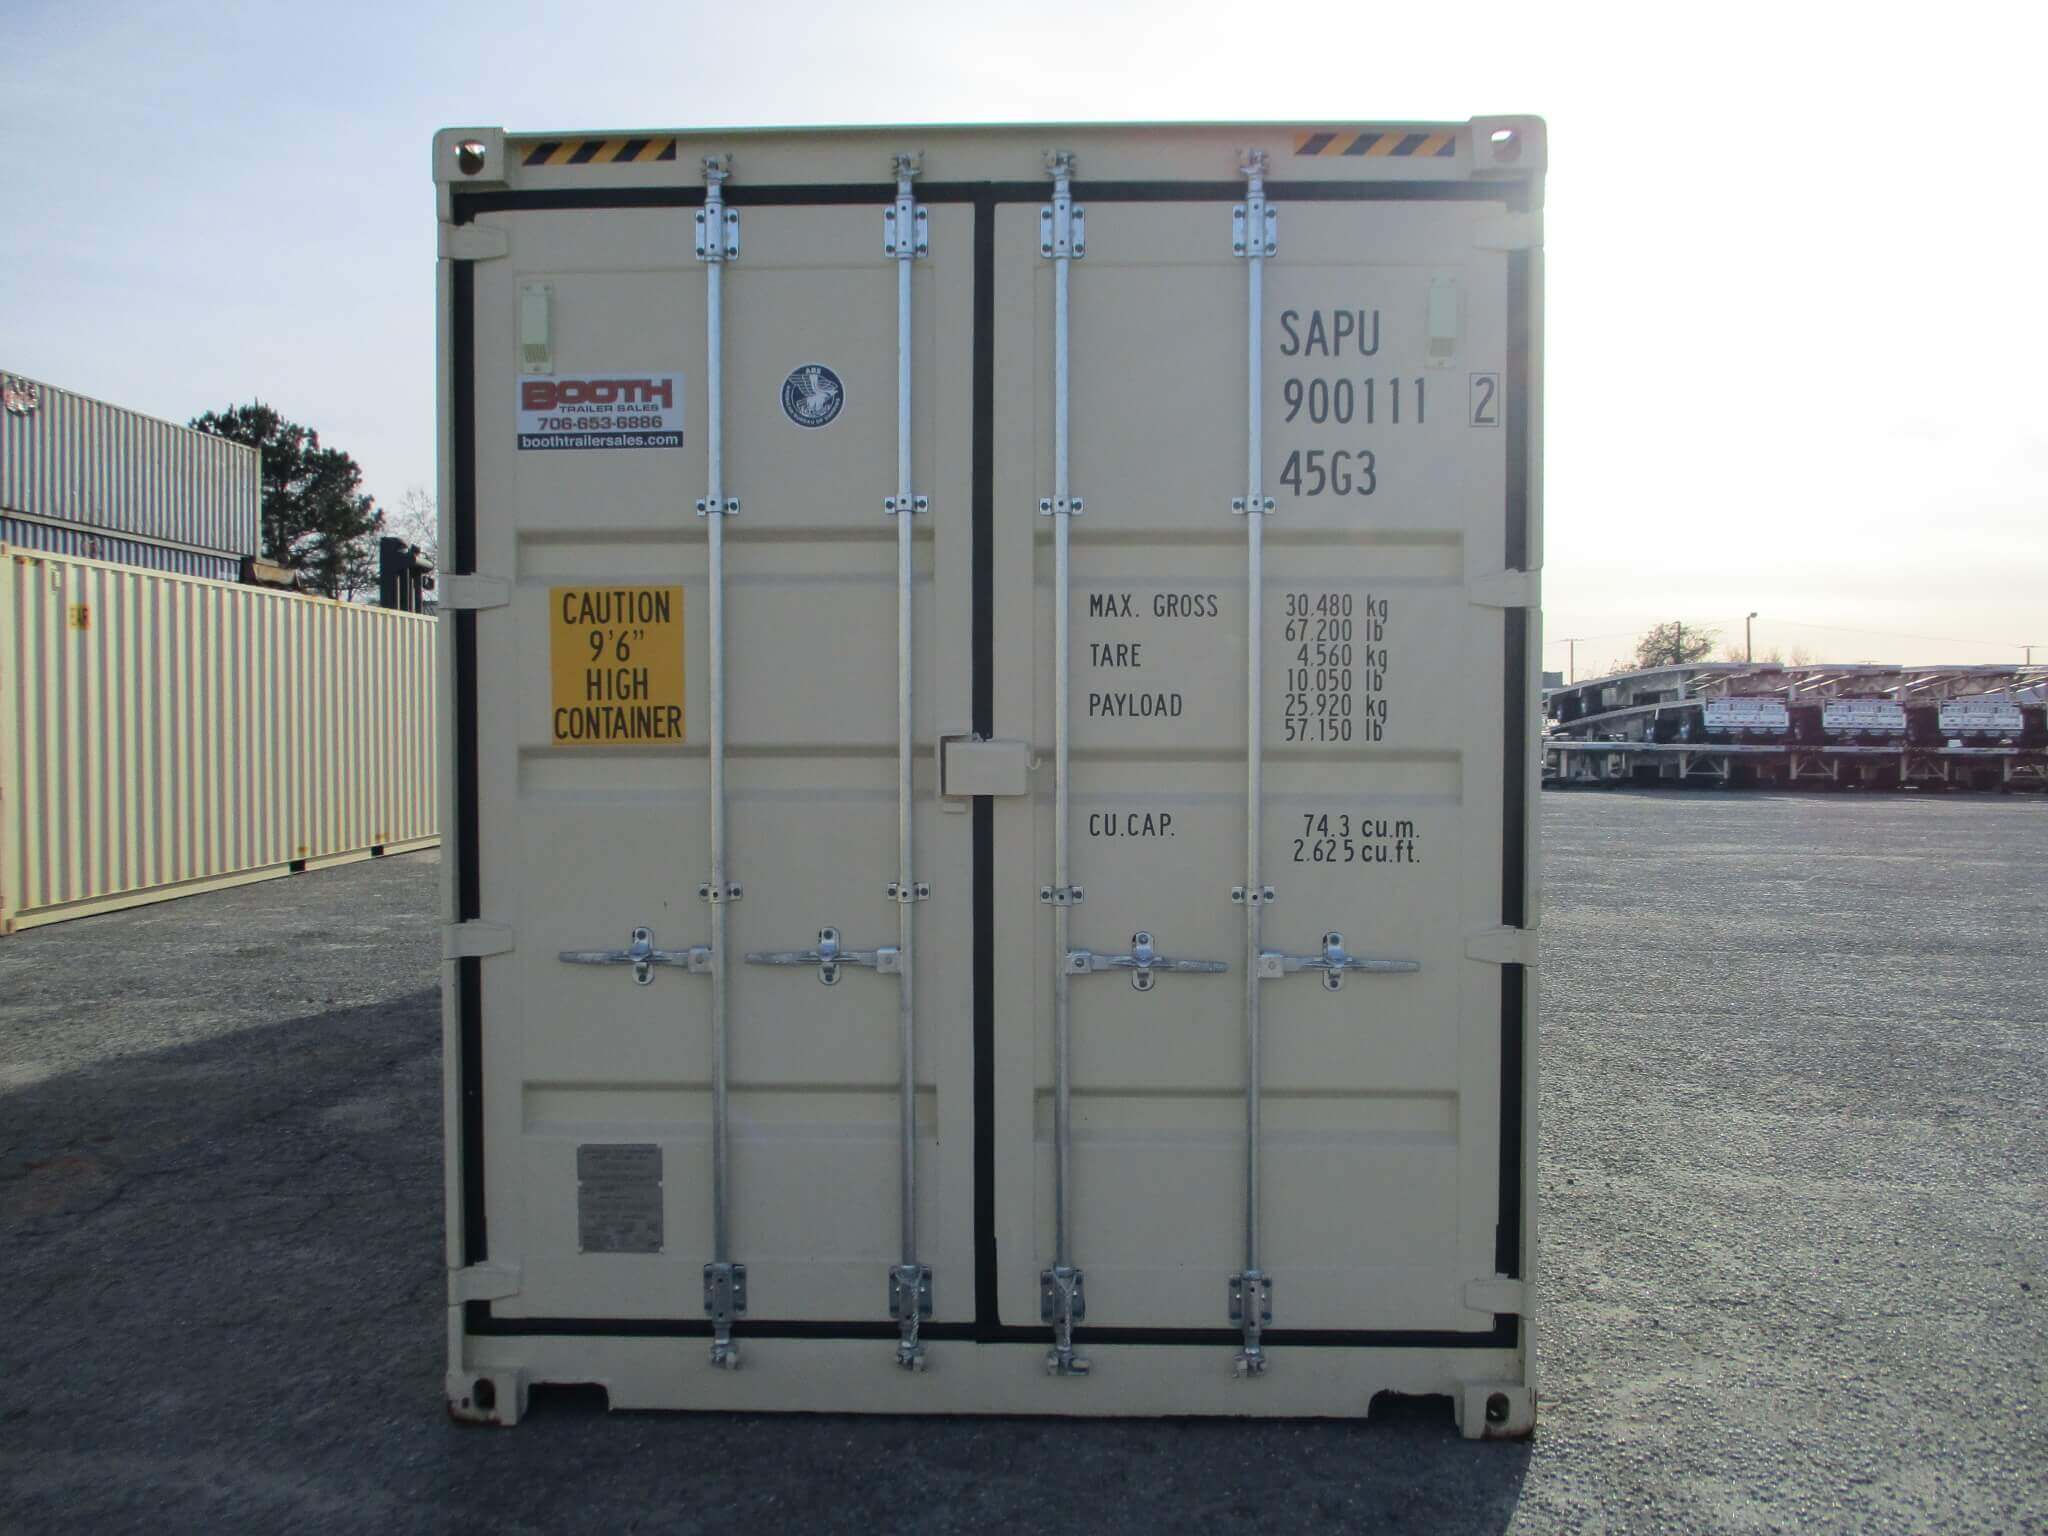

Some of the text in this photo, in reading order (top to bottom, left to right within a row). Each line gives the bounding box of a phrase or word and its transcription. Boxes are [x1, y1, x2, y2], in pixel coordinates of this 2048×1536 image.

[1280, 310, 1379, 356] SAPU
[522, 379, 672, 411] BOOTH
[559, 403, 659, 413] TRAILER SALES
[1284, 377, 1495, 424] 900111 2
[537, 415, 663, 431] 706-653-6886
[522, 434, 678, 448] boothtrailersales.com
[1280, 450, 1376, 496] 45G3
[563, 591, 671, 625] CAUTION
[1090, 594, 1140, 617] MAX.
[1153, 594, 1218, 617] GROSS
[1366, 594, 1388, 624] kg
[1366, 619, 1383, 642] lb
[1090, 644, 1142, 667] TARE
[1366, 644, 1388, 674] kg
[587, 668, 649, 701] HIGH
[1366, 669, 1383, 691] lb
[554, 706, 682, 739] CONTAINER
[1089, 693, 1183, 717] PAYLOAD
[1366, 694, 1388, 724] kg
[1366, 719, 1382, 741] lb
[1089, 813, 1420, 838] CU.CAP. 74.3 cu.m.
